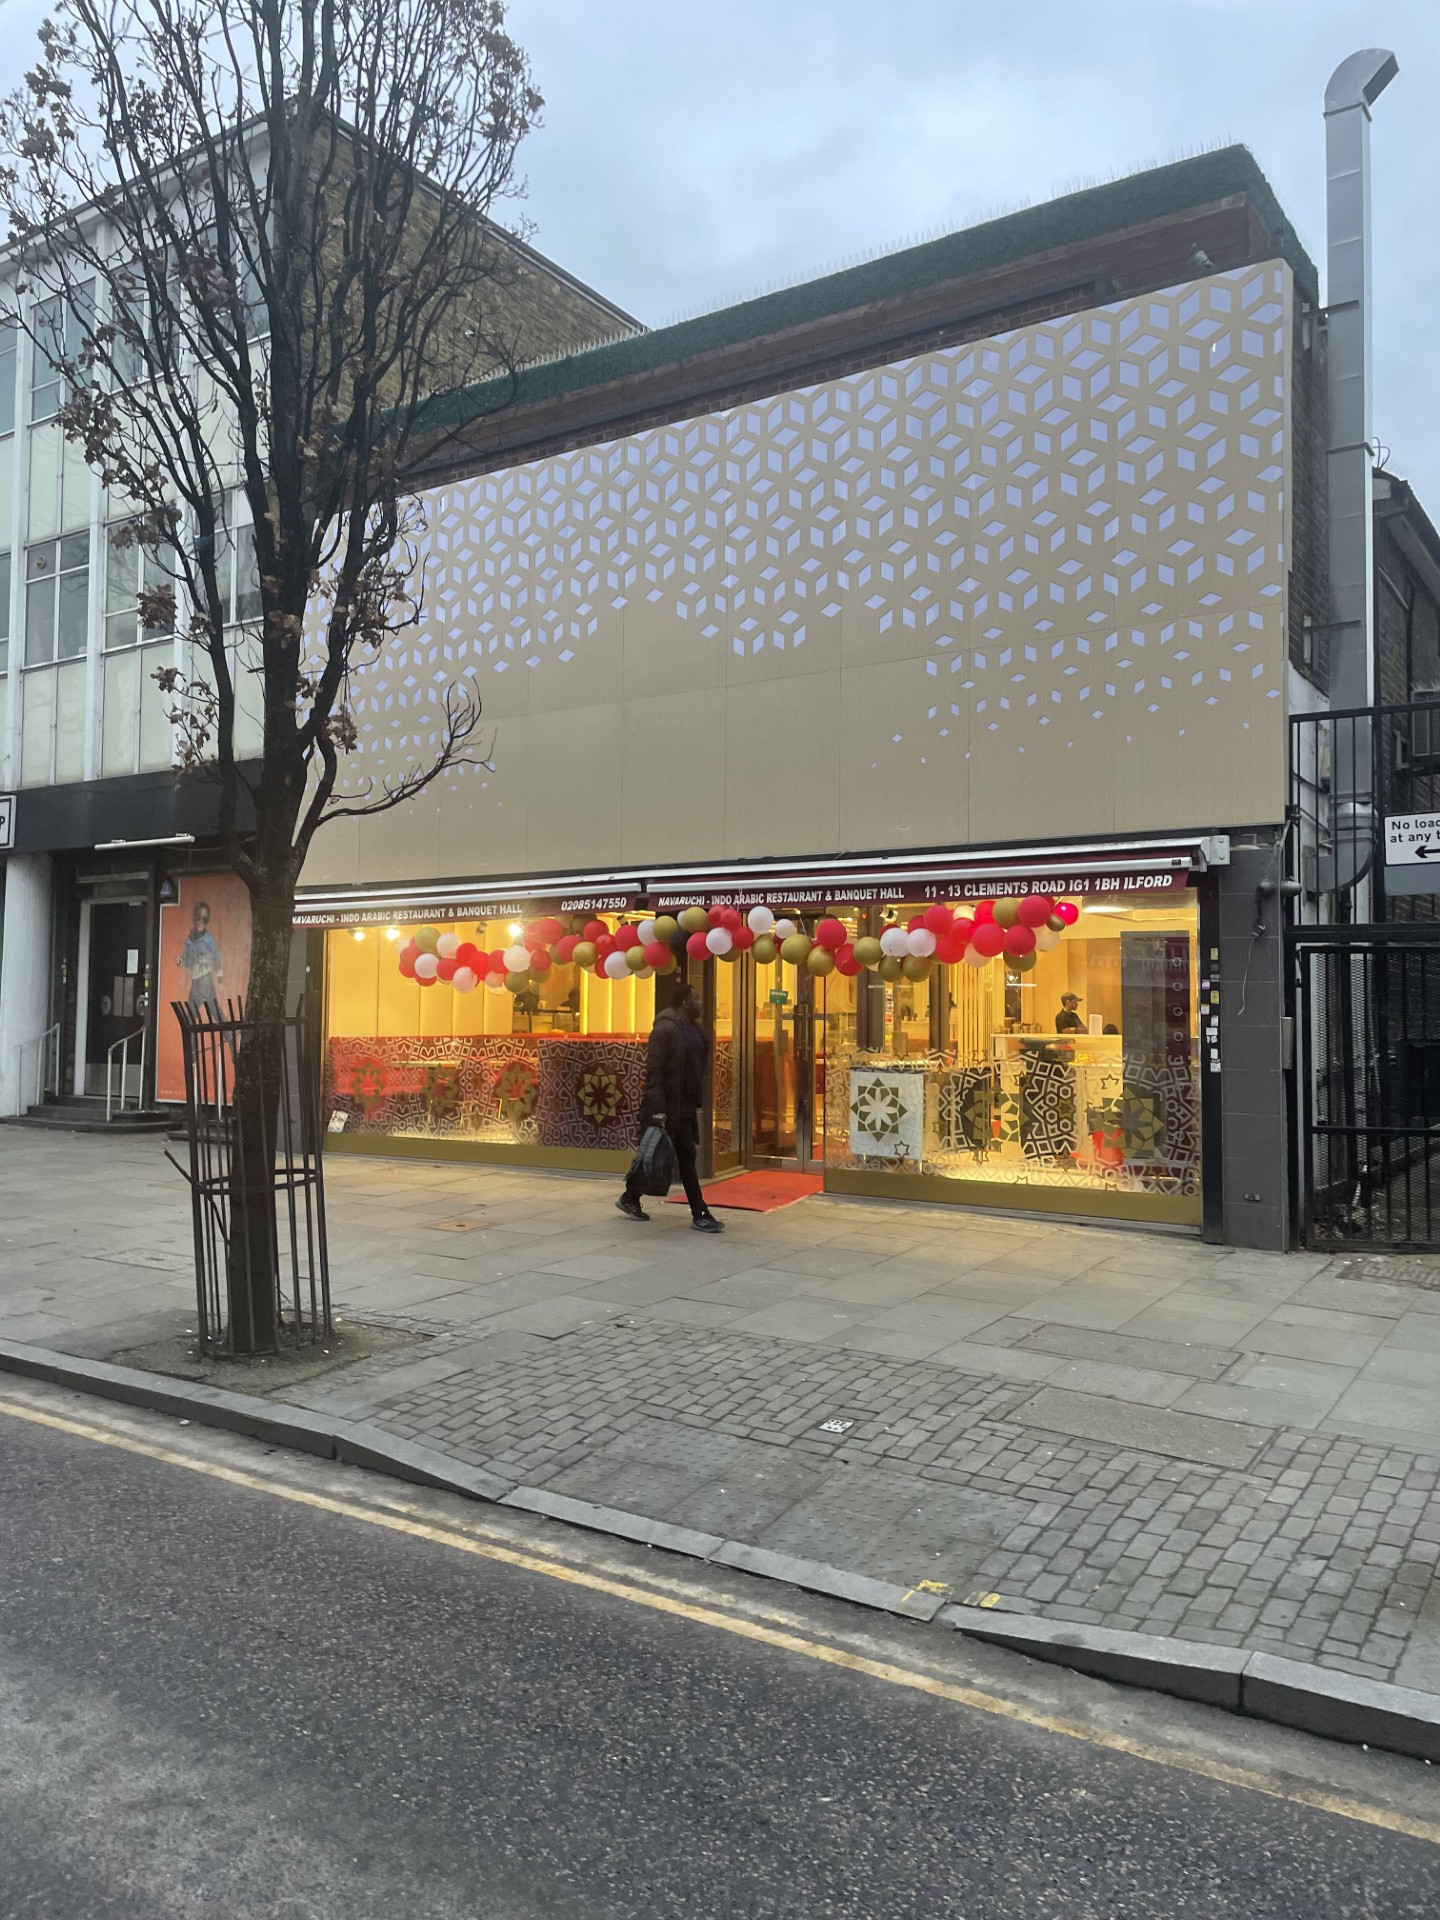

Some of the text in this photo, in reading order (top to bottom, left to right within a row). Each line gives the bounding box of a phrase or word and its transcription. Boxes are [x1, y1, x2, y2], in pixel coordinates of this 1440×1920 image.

[1391, 820, 1410, 830] No
[1390, 833, 1403, 843] at
[1408, 833, 1431, 843] any
[924, 885, 937, 898] 11
[948, 884, 961, 897] 13
[964, 881, 1028, 896] CLEMENTS
[1031, 879, 1066, 894] ROAD
[1068, 879, 1090, 892] IG1
[1094, 877, 1120, 891] 1BH
[1123, 874, 1173, 890] ILFORD
[658, 895, 705, 907] NAVARUCHI
[711, 894, 732, 906] INDO
[733, 892, 765, 905] ARABIC
[766, 890, 823, 904] RESTAURANT
[825, 890, 831, 901] &
[834, 888, 878, 901] BANQUET
[880, 887, 905, 899] HALL
[340, 912, 360, 923] INDO
[361, 910, 391, 922] ARABIC
[392, 908, 447, 920] RESTAURANT
[448, 907, 454, 917] &
[456, 905, 498, 917] BANQUET
[500, 904, 522, 914] HALL
[561, 896, 627, 911] 02085147550
